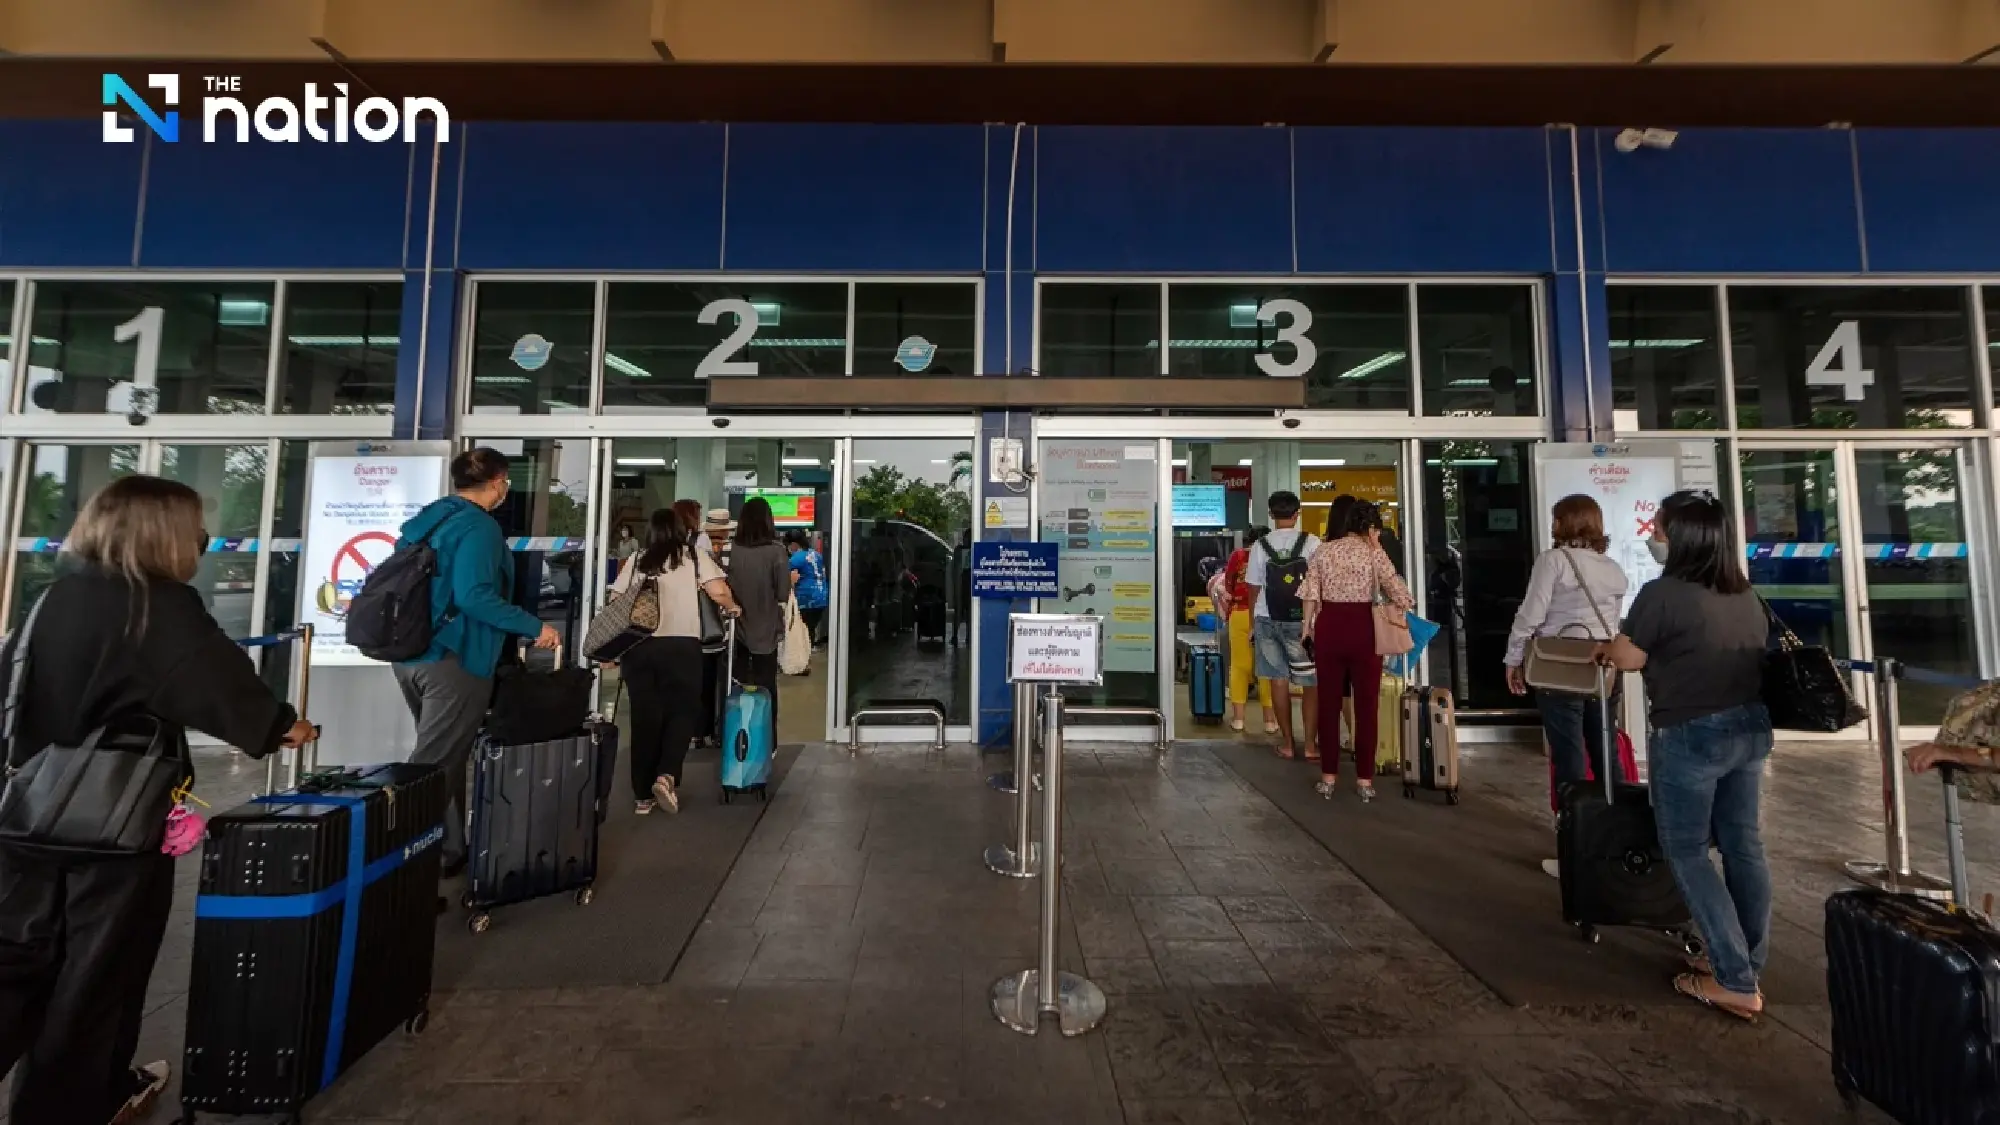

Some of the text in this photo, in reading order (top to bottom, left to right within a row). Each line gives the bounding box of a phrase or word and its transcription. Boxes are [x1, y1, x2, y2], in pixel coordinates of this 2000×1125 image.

[113, 306, 165, 389] 1
[694, 298, 759, 378] 2
[1255, 299, 1317, 377] 3
[1805, 320, 1875, 401] 4
[1588, 463, 1630, 475] คำเตือน
[1634, 499, 1656, 512] No
